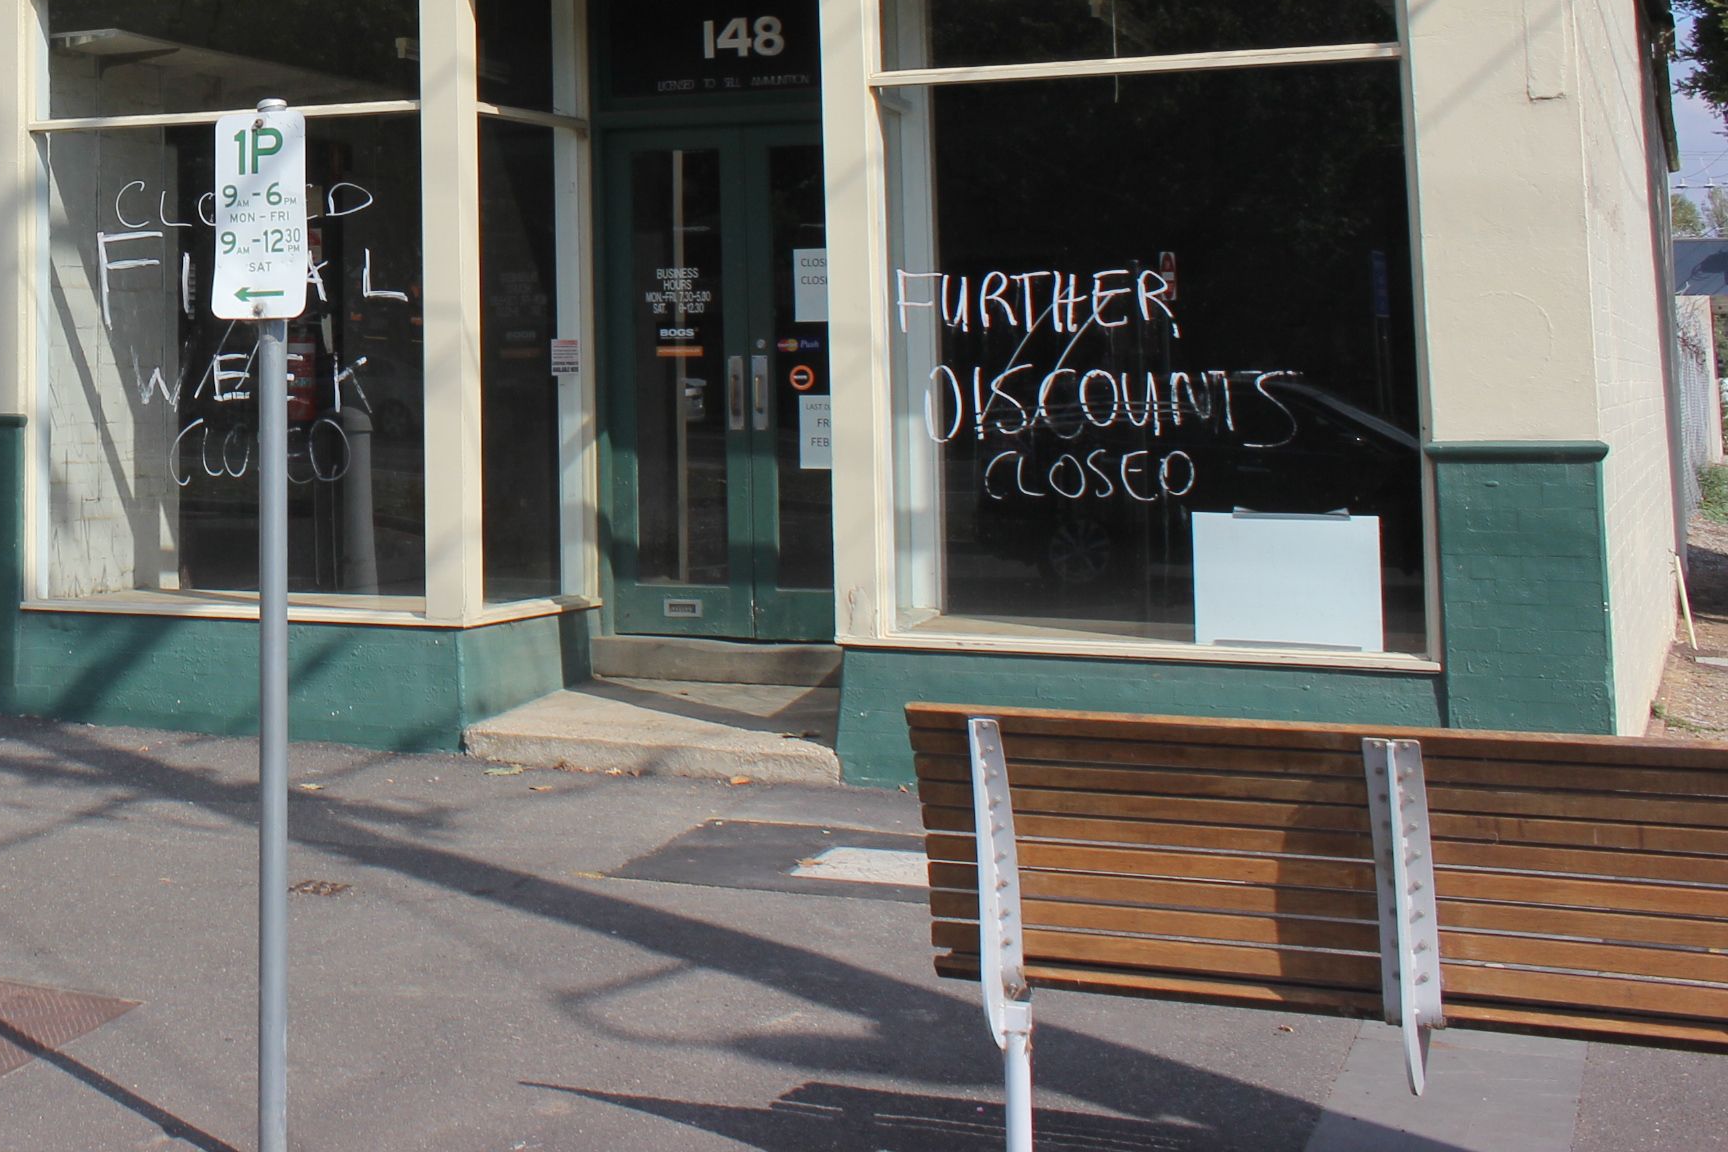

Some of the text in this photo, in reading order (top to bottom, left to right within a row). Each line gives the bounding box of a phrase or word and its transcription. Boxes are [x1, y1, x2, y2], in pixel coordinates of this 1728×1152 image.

[703, 15, 785, 59] 148
[234, 128, 283, 175] 1P
[116, 180, 373, 229] CLOD
[230, 212, 255, 223] MON
[270, 210, 290, 221] FRI
[96, 231, 409, 331] FIAL
[249, 262, 272, 273] SAT
[656, 268, 699, 280] BUSINESS
[663, 280, 692, 291] HOURS
[896, 269, 1180, 339] FURTHER
[660, 328, 695, 337] BOGS
[924, 364, 1304, 448] DISCOUNTS
[170, 417, 351, 487] CLOED
[985, 449, 1195, 501] CLOSED
